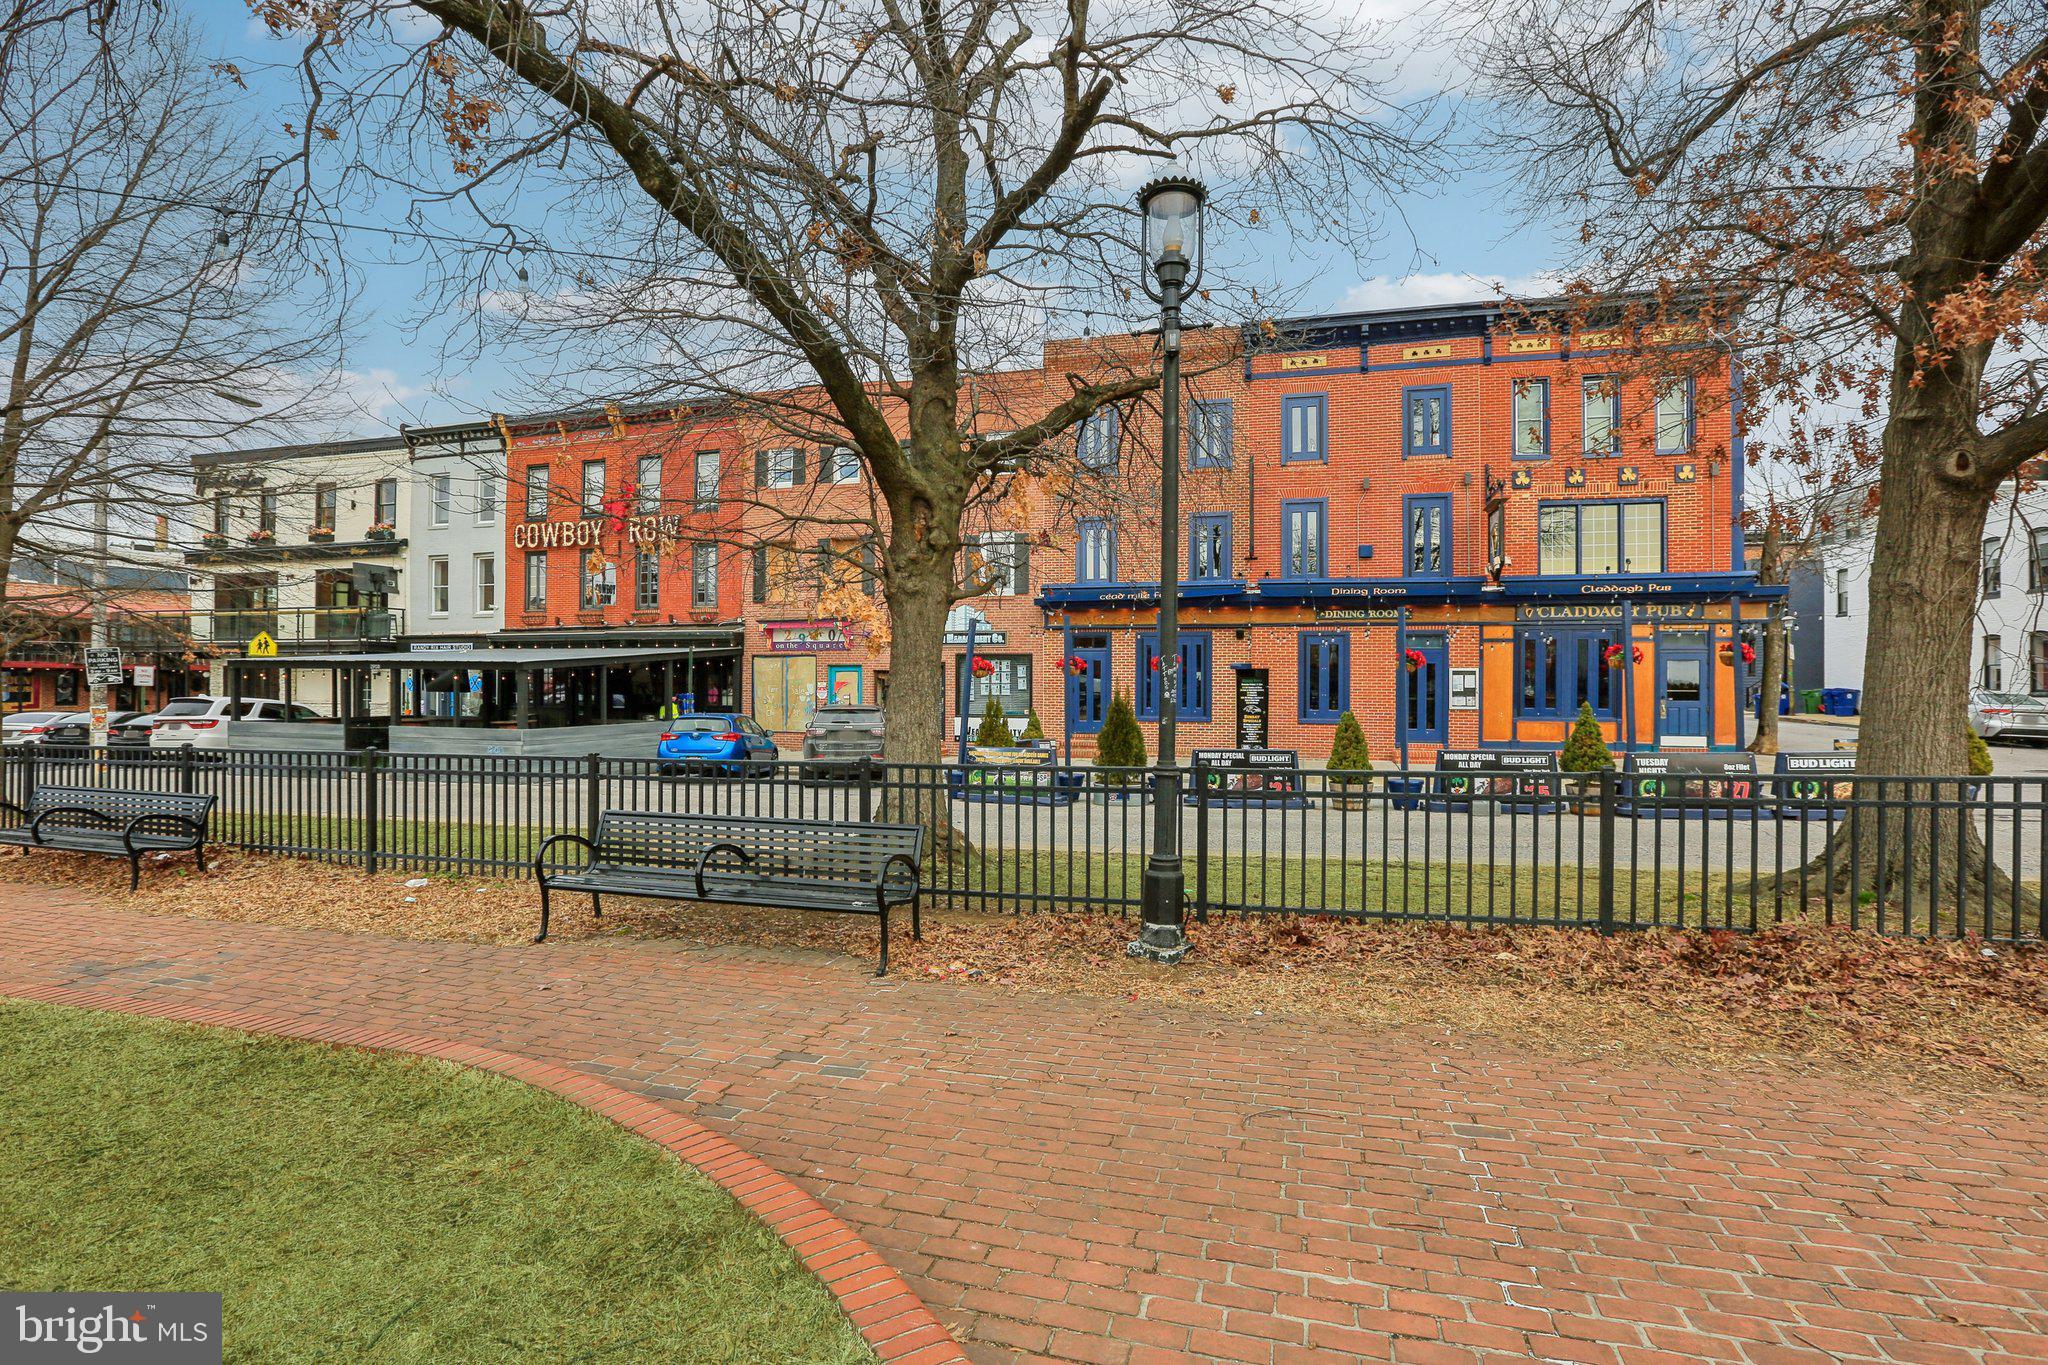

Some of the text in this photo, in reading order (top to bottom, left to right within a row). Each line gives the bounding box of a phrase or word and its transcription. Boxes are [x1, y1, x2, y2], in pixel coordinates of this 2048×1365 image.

[514, 515, 681, 548] COWBOY ROW
[1331, 587, 1407, 596] Dining Room
[1581, 584, 1643, 593] Claddagh
[1324, 609, 1365, 618] DINING
[1645, 605, 1682, 617] PUB
[1222, 752, 1245, 760] SPECIAL
[1268, 755, 1291, 763] LIGHT
[1443, 753, 1496, 761] MONDAY SPECIAL
[1210, 759, 1232, 767] ALL DAY
[1469, 761, 1482, 769] DAY
[1635, 758, 1669, 767] TUESDAY
[1790, 758, 1857, 768] BUD LIGHT
